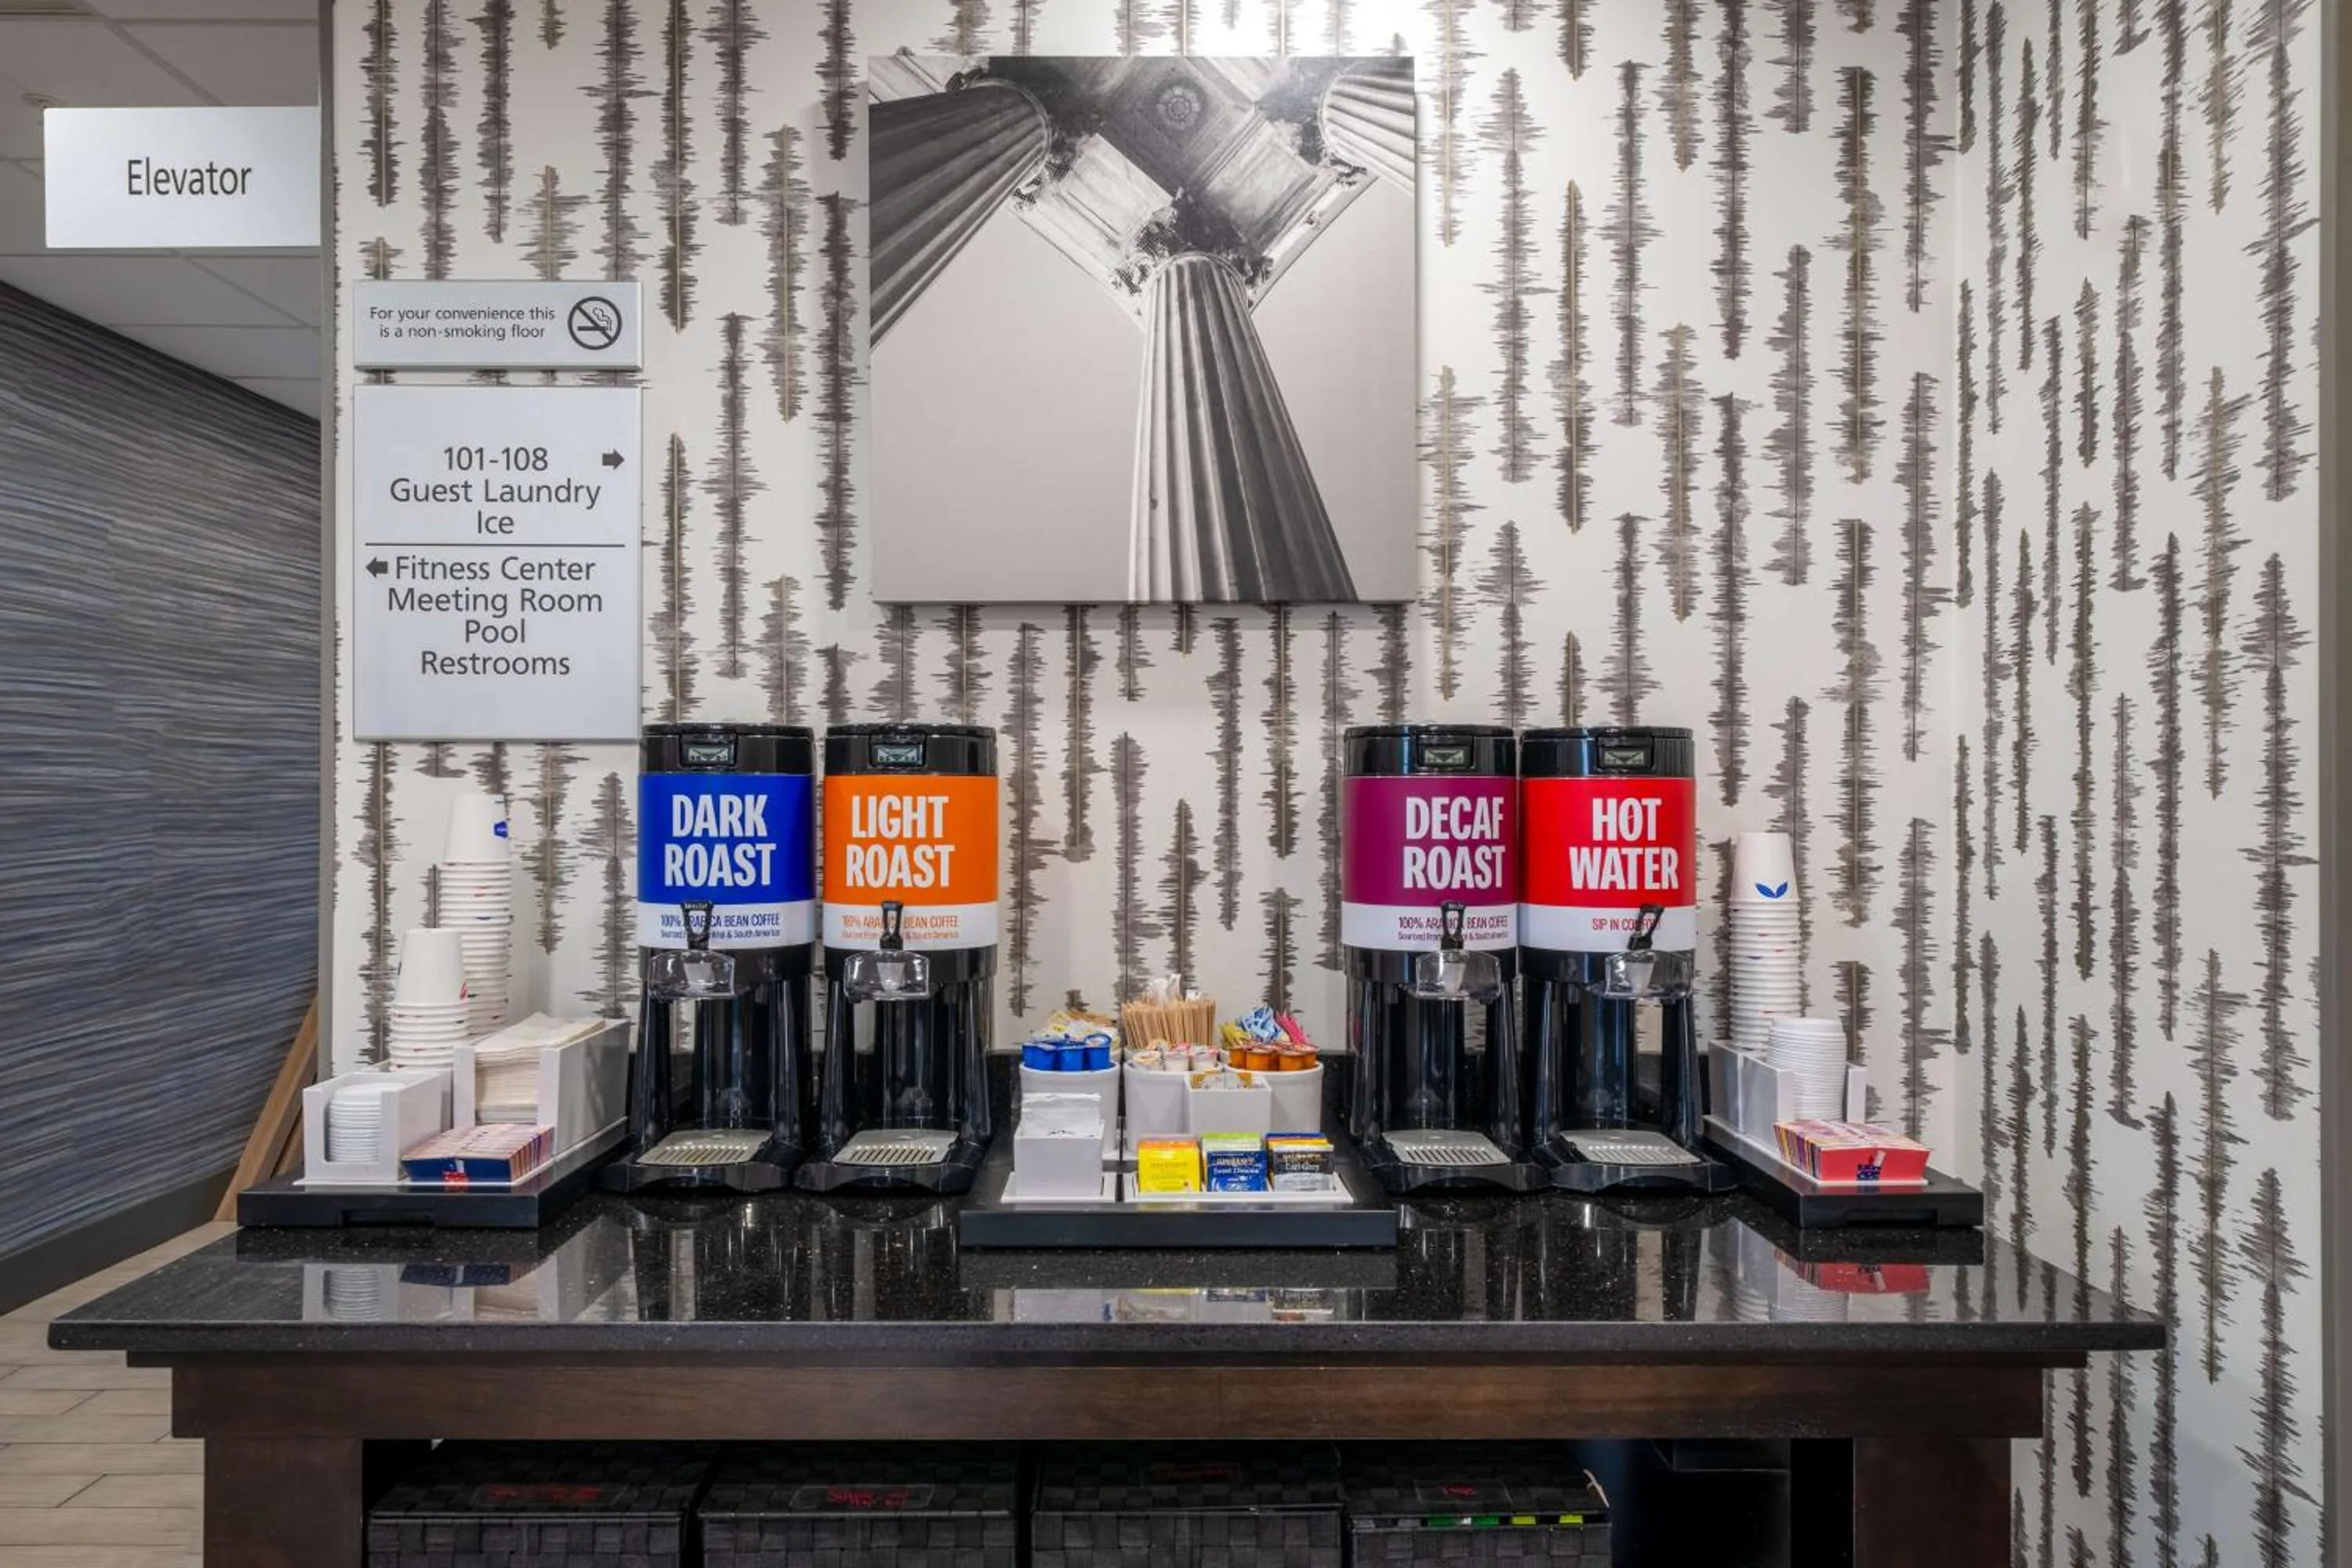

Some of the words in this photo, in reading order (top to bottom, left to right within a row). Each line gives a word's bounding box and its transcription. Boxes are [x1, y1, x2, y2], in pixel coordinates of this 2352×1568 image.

[127, 158, 252, 196] Elevator
[369, 307, 394, 320] For
[397, 310, 431, 323] your
[434, 307, 525, 320] convenience
[528, 307, 556, 320] this
[379, 325, 390, 338] is
[394, 328, 403, 338] a
[408, 325, 506, 341] non-smoking
[510, 324, 546, 338] floor
[443, 447, 549, 472] 101-108
[390, 479, 473, 504] Guest
[484, 479, 601, 509] Laundry
[477, 510, 515, 535] Ice
[396, 555, 490, 581] Fitness
[501, 556, 596, 581] Center
[388, 586, 508, 619] Meeting
[520, 588, 602, 612] Room
[465, 619, 526, 644] Pool
[421, 651, 570, 676] Restrooms
[672, 793, 768, 838] DARK
[851, 795, 949, 838] LIGHT
[1405, 797, 1504, 840] DECAF
[1592, 797, 1662, 841] HOT
[664, 843, 776, 887] ROAST
[846, 844, 956, 887] ROAST
[1403, 846, 1505, 890] ROAST
[1569, 847, 1679, 891] WATER
[724, 914, 749, 927] BEAN
[751, 913, 781, 926] COFFEE
[930, 915, 958, 928] COFFEE
[1398, 916, 1424, 929] 100%
[1468, 916, 1487, 929] BEAN
[1592, 918, 1607, 931] SIP
[1610, 918, 1619, 931] IN
